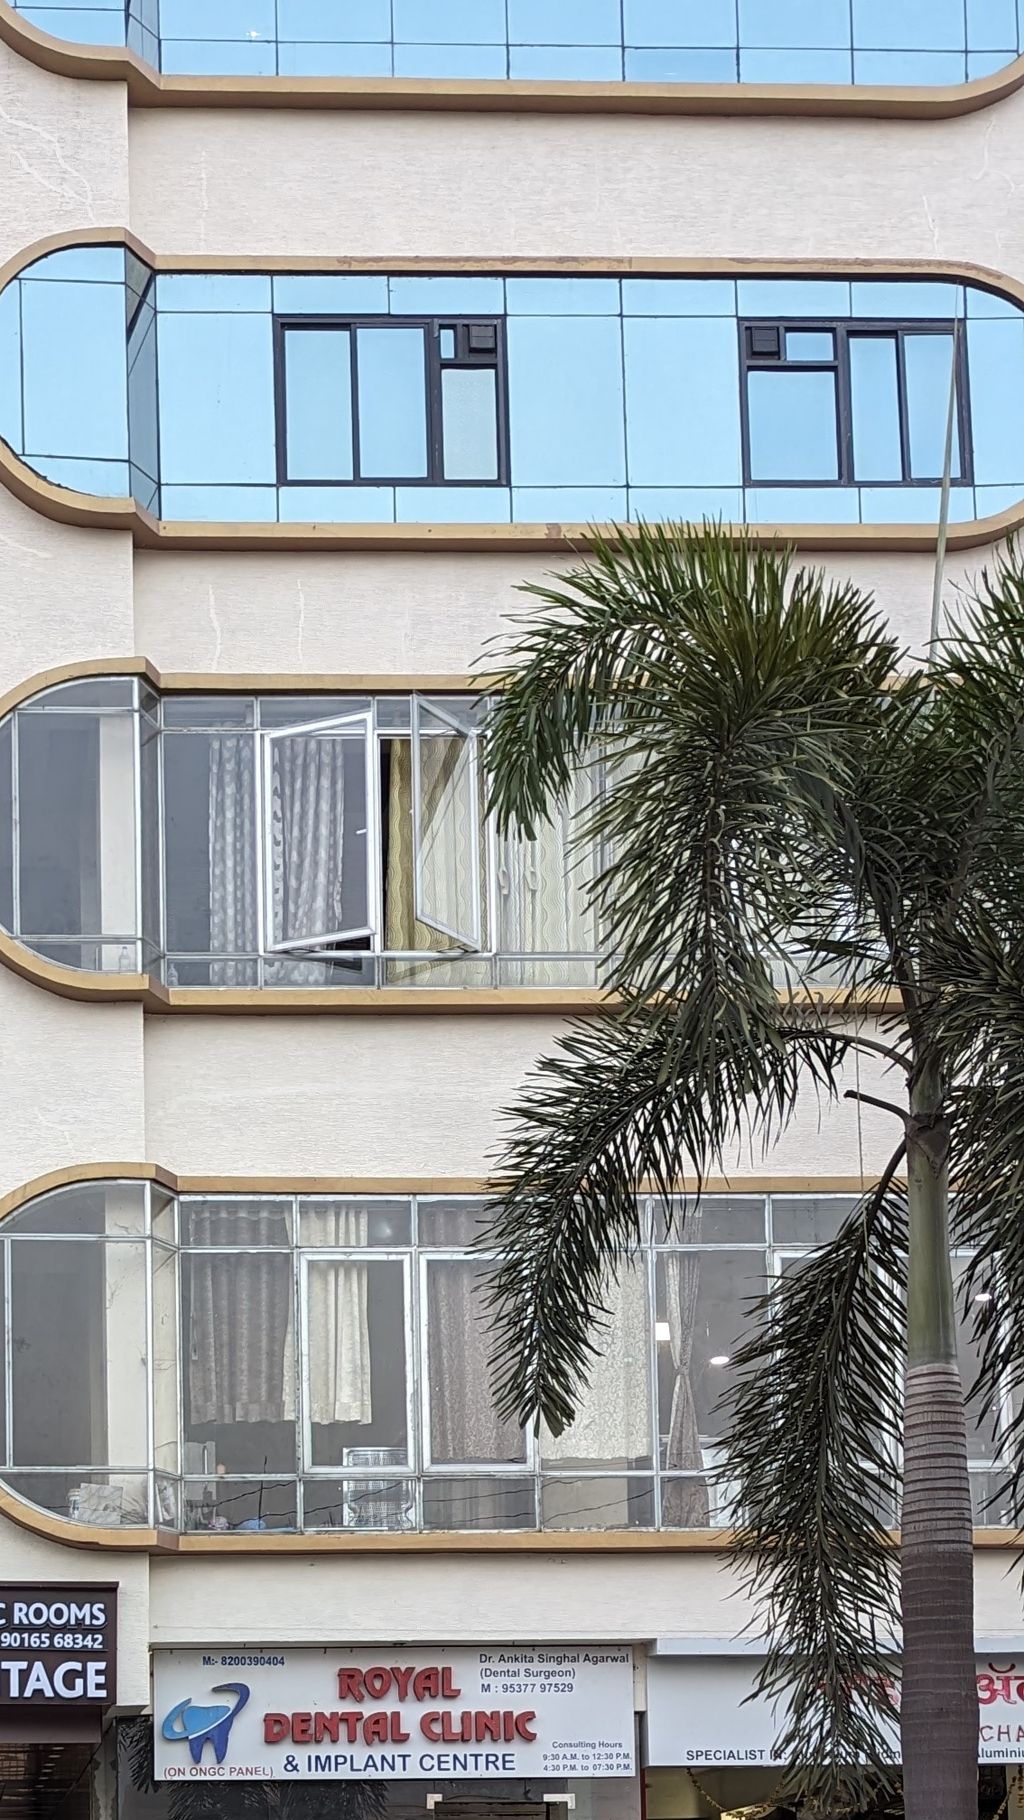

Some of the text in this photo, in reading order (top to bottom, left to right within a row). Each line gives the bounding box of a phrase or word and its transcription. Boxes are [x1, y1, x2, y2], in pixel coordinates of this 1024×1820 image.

[12, 1602, 106, 1627] ROOMS
[0, 1632, 52, 1649] 90165
[54, 1632, 104, 1649] 68342
[220, 1655, 285, 1667] 8200390404
[479, 1653, 629, 1666] Dr. Ankita Singhal Agarwal
[479, 1667, 576, 1680] (Dental Surgeon)
[337, 1666, 462, 1703] ROYAL
[501, 1683, 536, 1693] 95377
[539, 1683, 574, 1693] 97529
[263, 1709, 538, 1746] DENTAL CLINIC
[552, 1740, 623, 1750] Consulting Hours
[542, 1753, 560, 1761] 9:30
[581, 1753, 590, 1761] to
[592, 1752, 614, 1760] 12:30
[686, 1749, 765, 1761] SPECIALIST
[284, 1752, 516, 1773] & IMPLANT CENTRE
[543, 1764, 560, 1772] 4:30
[581, 1763, 589, 1771] to
[592, 1763, 614, 1771] 07:30
[163, 1765, 274, 1779] (ON ONGC PANEL)
